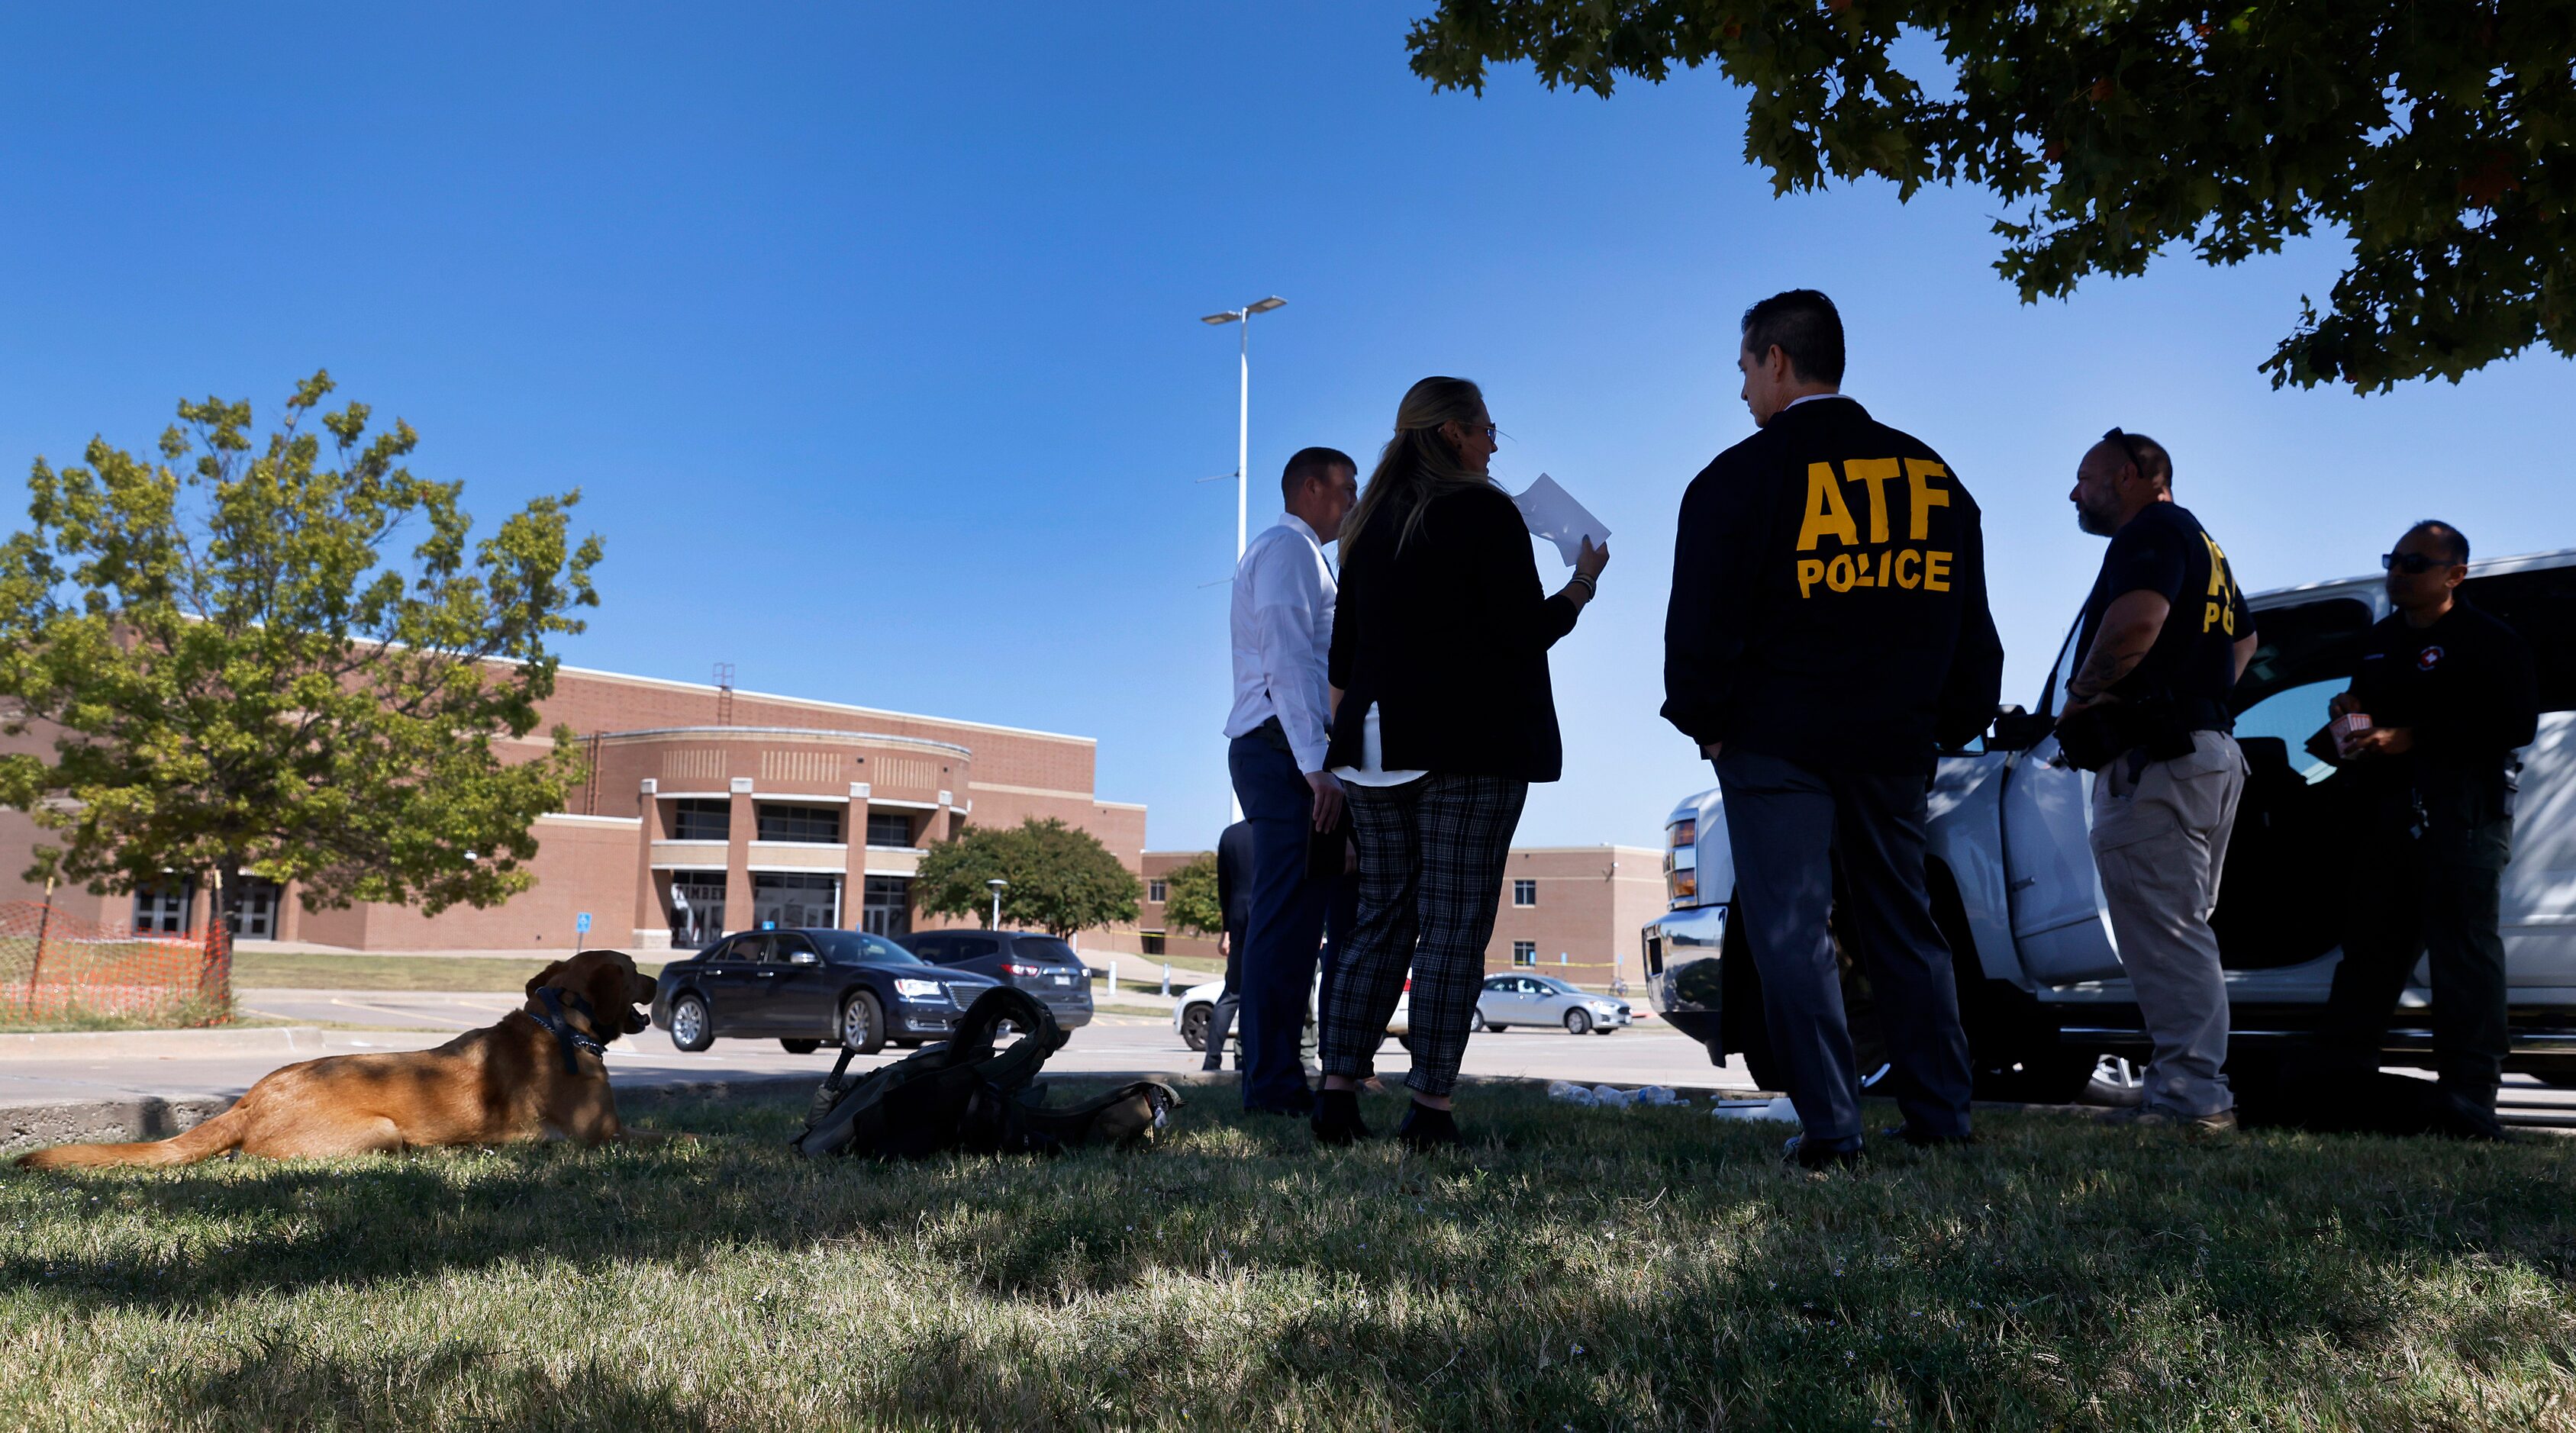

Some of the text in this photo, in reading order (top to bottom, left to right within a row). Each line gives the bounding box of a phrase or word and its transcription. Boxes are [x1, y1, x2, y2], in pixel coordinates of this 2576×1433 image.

[1797, 457, 1949, 551] ATF
[1797, 549, 1952, 598] POLICE
[2203, 601, 2234, 636] PO
[676, 886, 727, 900] TIMBER
